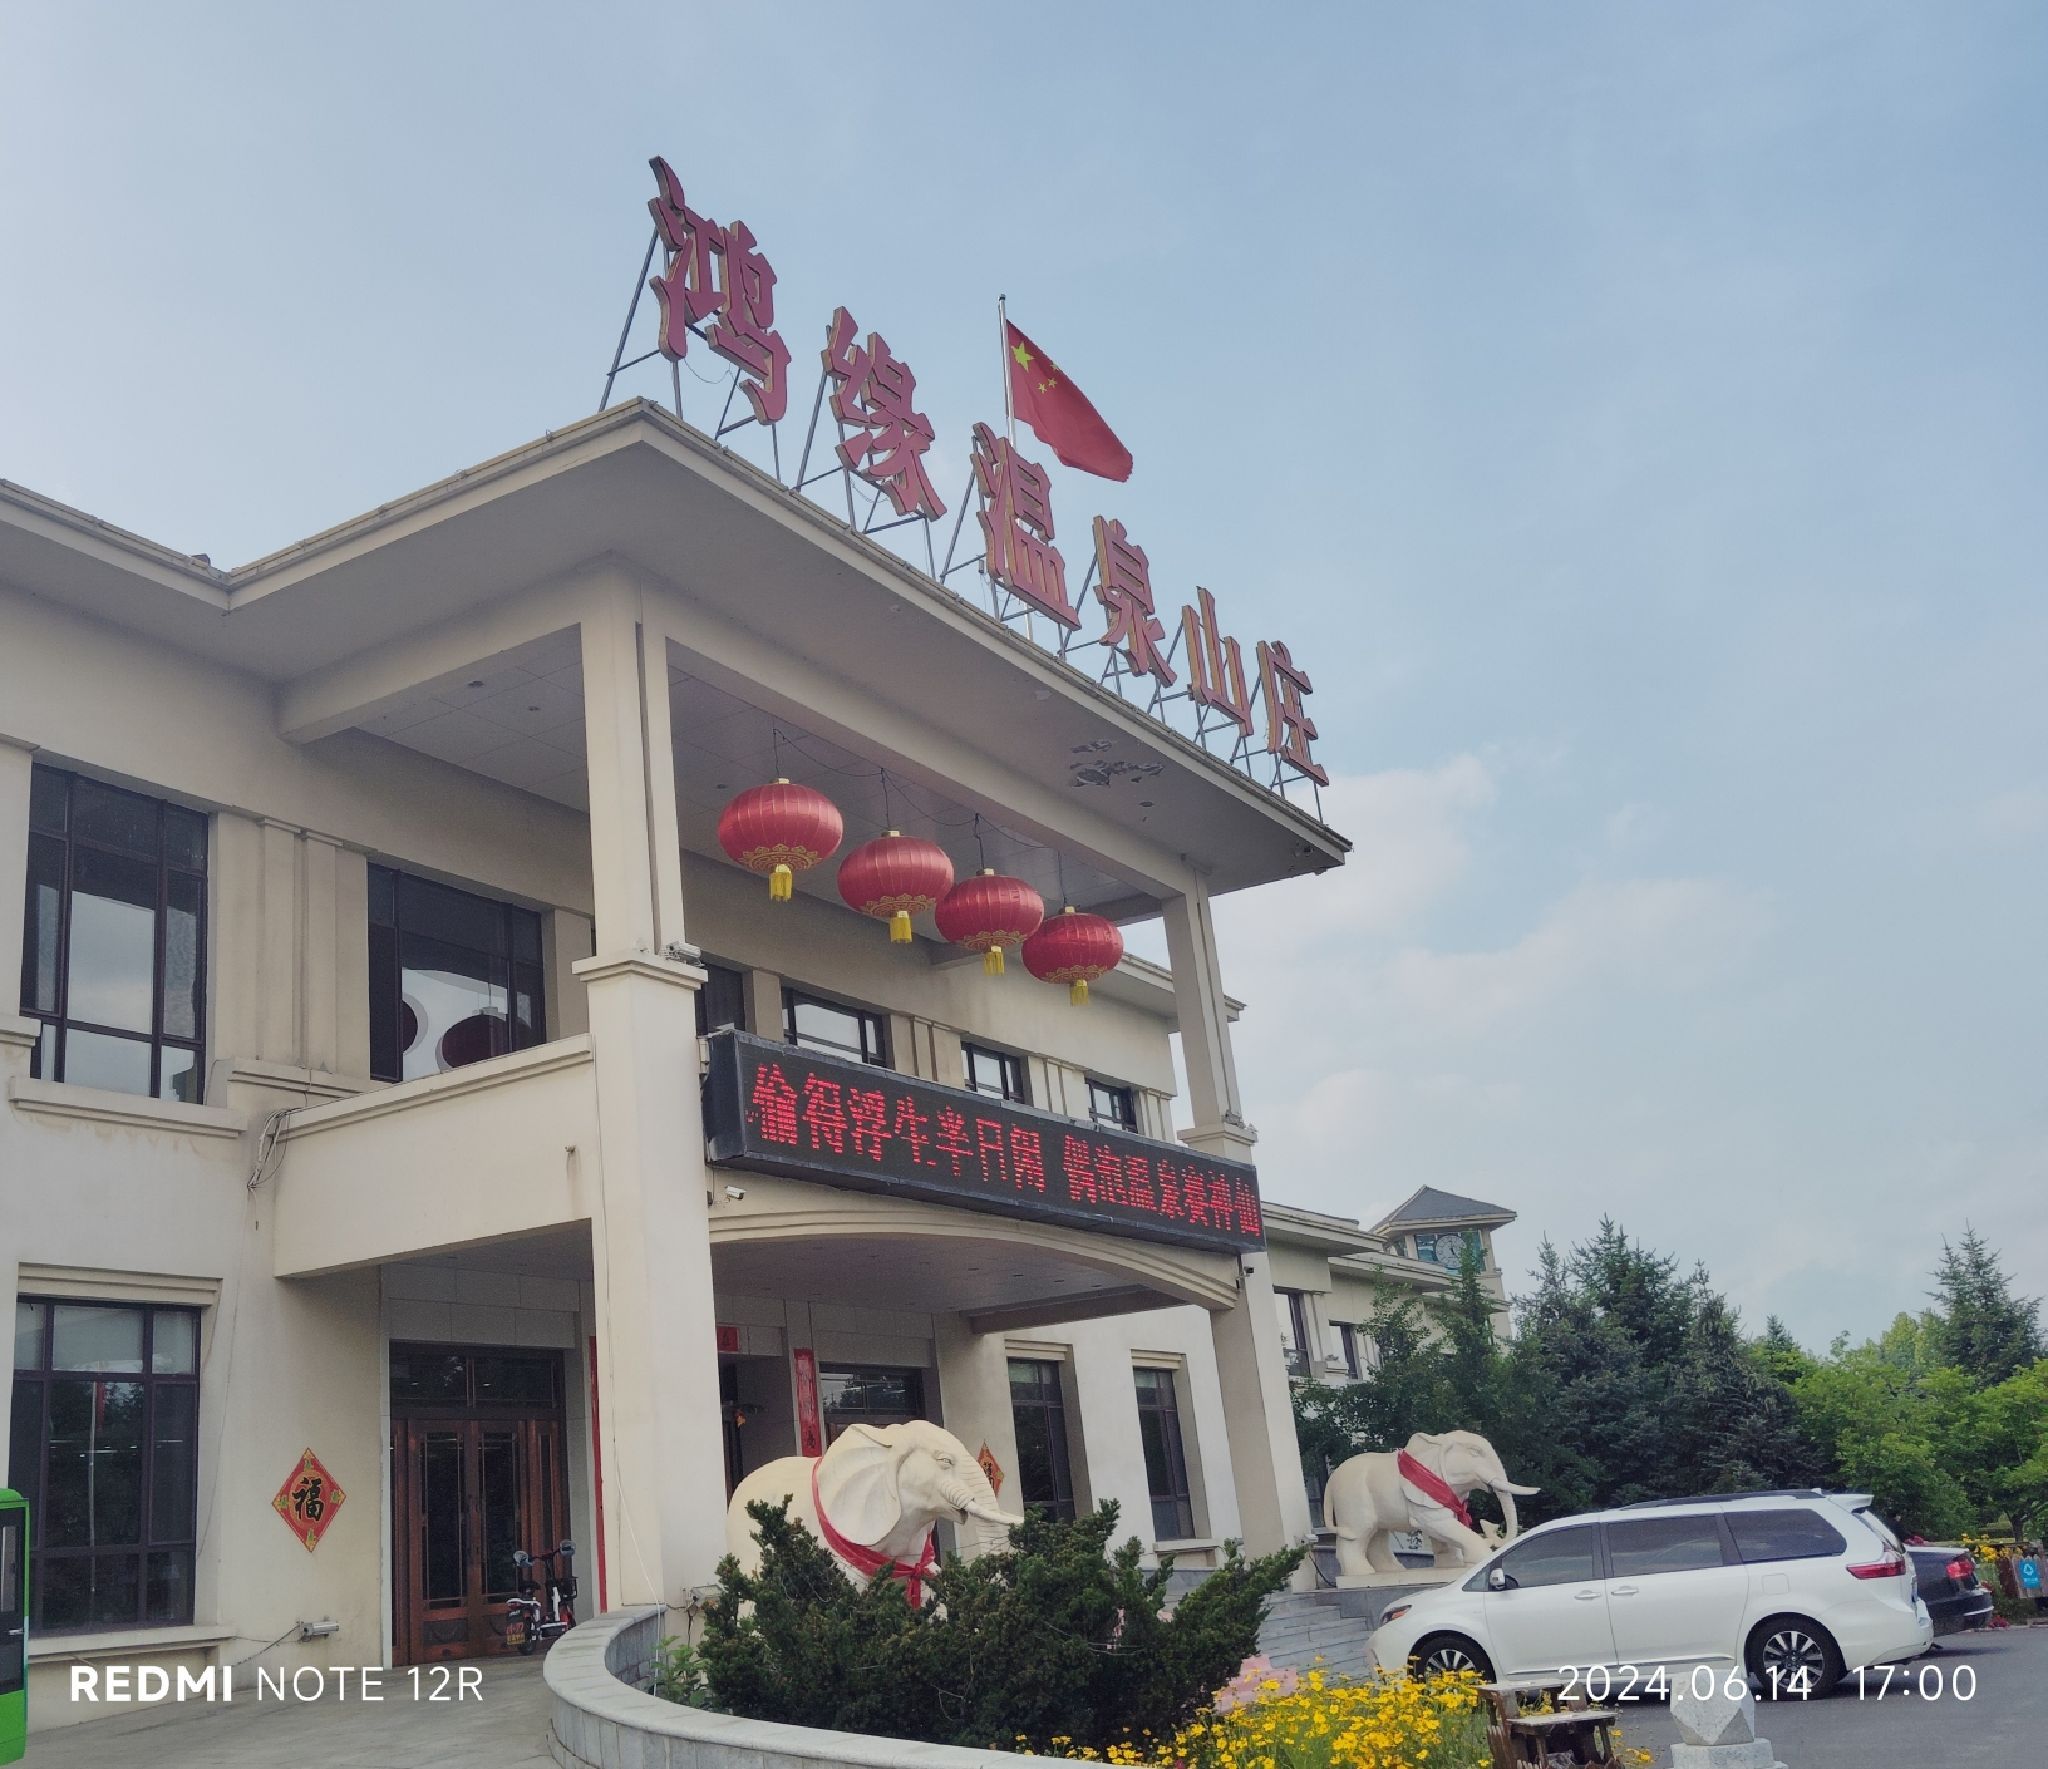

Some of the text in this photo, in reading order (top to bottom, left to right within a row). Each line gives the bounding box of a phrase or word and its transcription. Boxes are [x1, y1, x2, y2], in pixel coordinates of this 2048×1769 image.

[647, 155, 1330, 787] 鸿缘温泉山庄
[291, 1476, 325, 1522] 福
